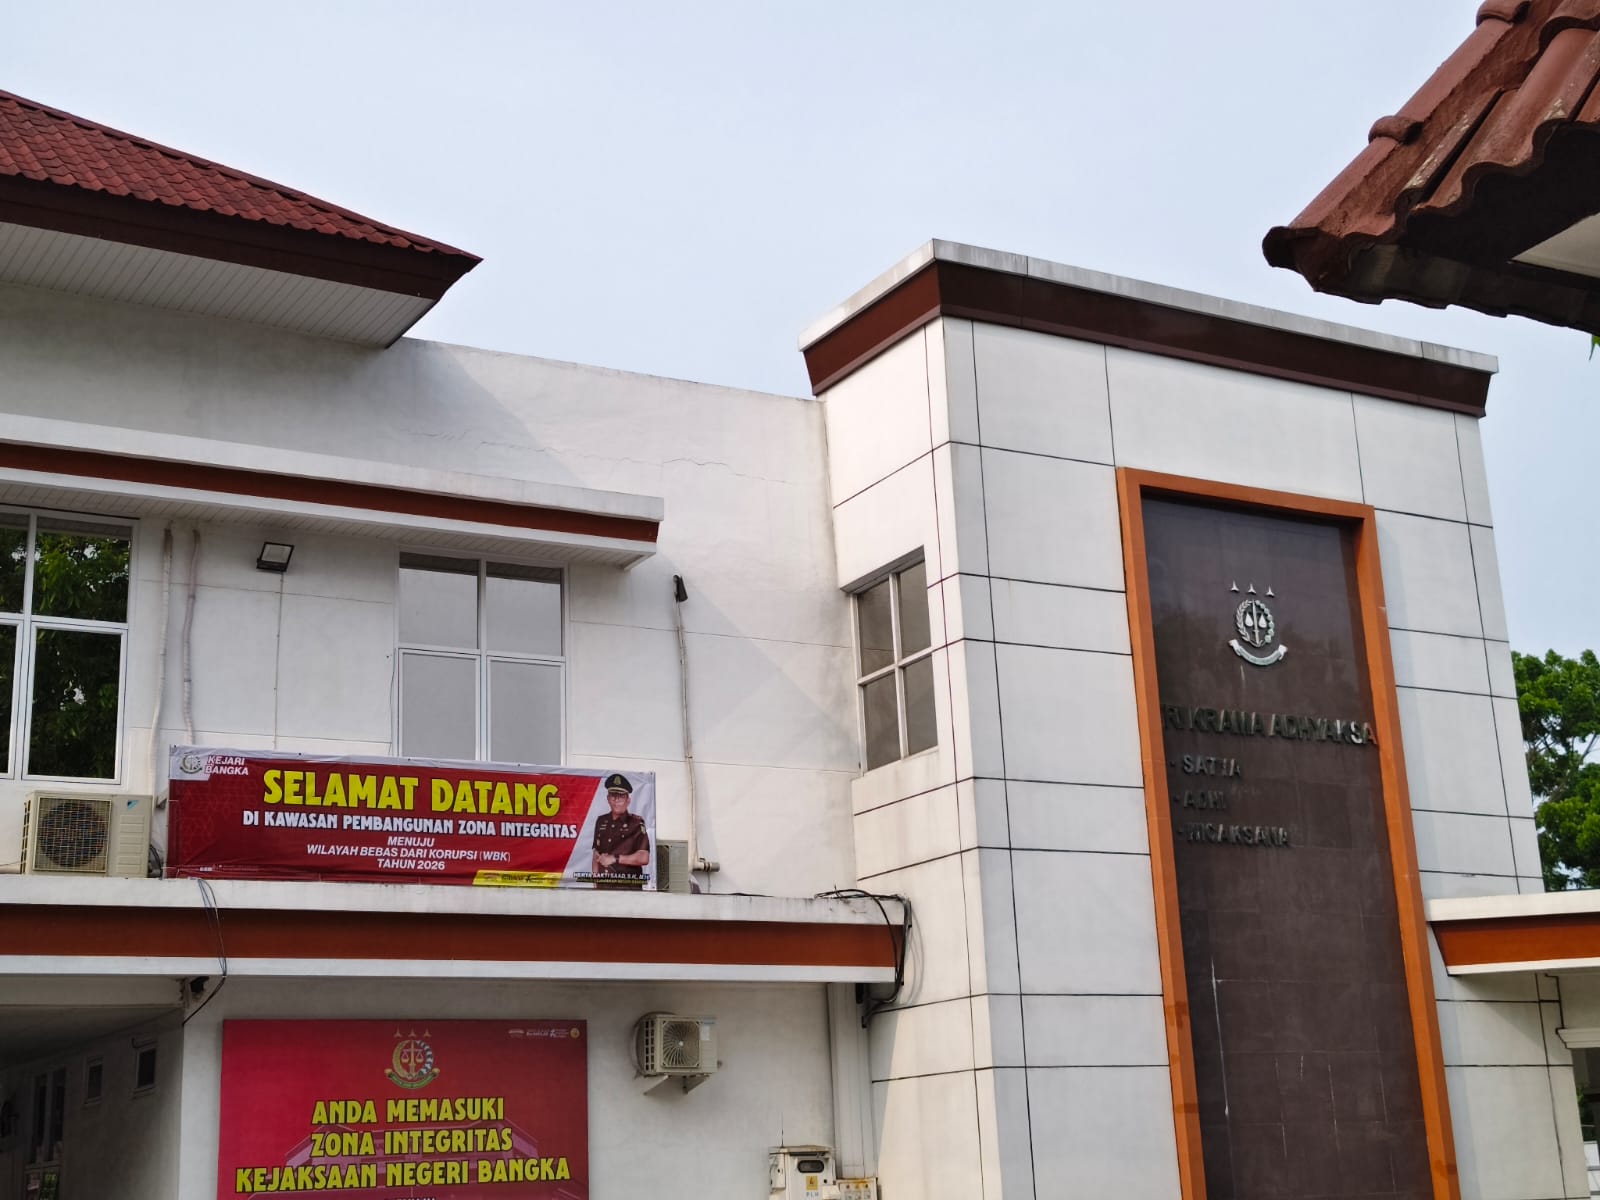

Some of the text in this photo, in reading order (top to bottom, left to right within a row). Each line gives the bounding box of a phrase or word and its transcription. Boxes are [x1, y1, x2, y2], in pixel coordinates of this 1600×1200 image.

[204, 765, 249, 776] BANGKA
[207, 755, 246, 766] KEJARI
[263, 769, 561, 817] SELAMAT DATANG
[242, 810, 577, 840] DI KAWASAN PEMBANGUNAN ZONA INTEGRITAS
[306, 844, 511, 863] WILAYAH BEBAS DARI KORUPSI (WBK)
[387, 836, 435, 848] MENUJU
[377, 858, 445, 871] TAHUN 2026
[312, 1097, 505, 1125] ANDA MEMASUKI
[310, 1128, 513, 1157] ZONA INTEGRITAS
[235, 1157, 571, 1193] KEJAKSAAN NEGERI BANGKA
